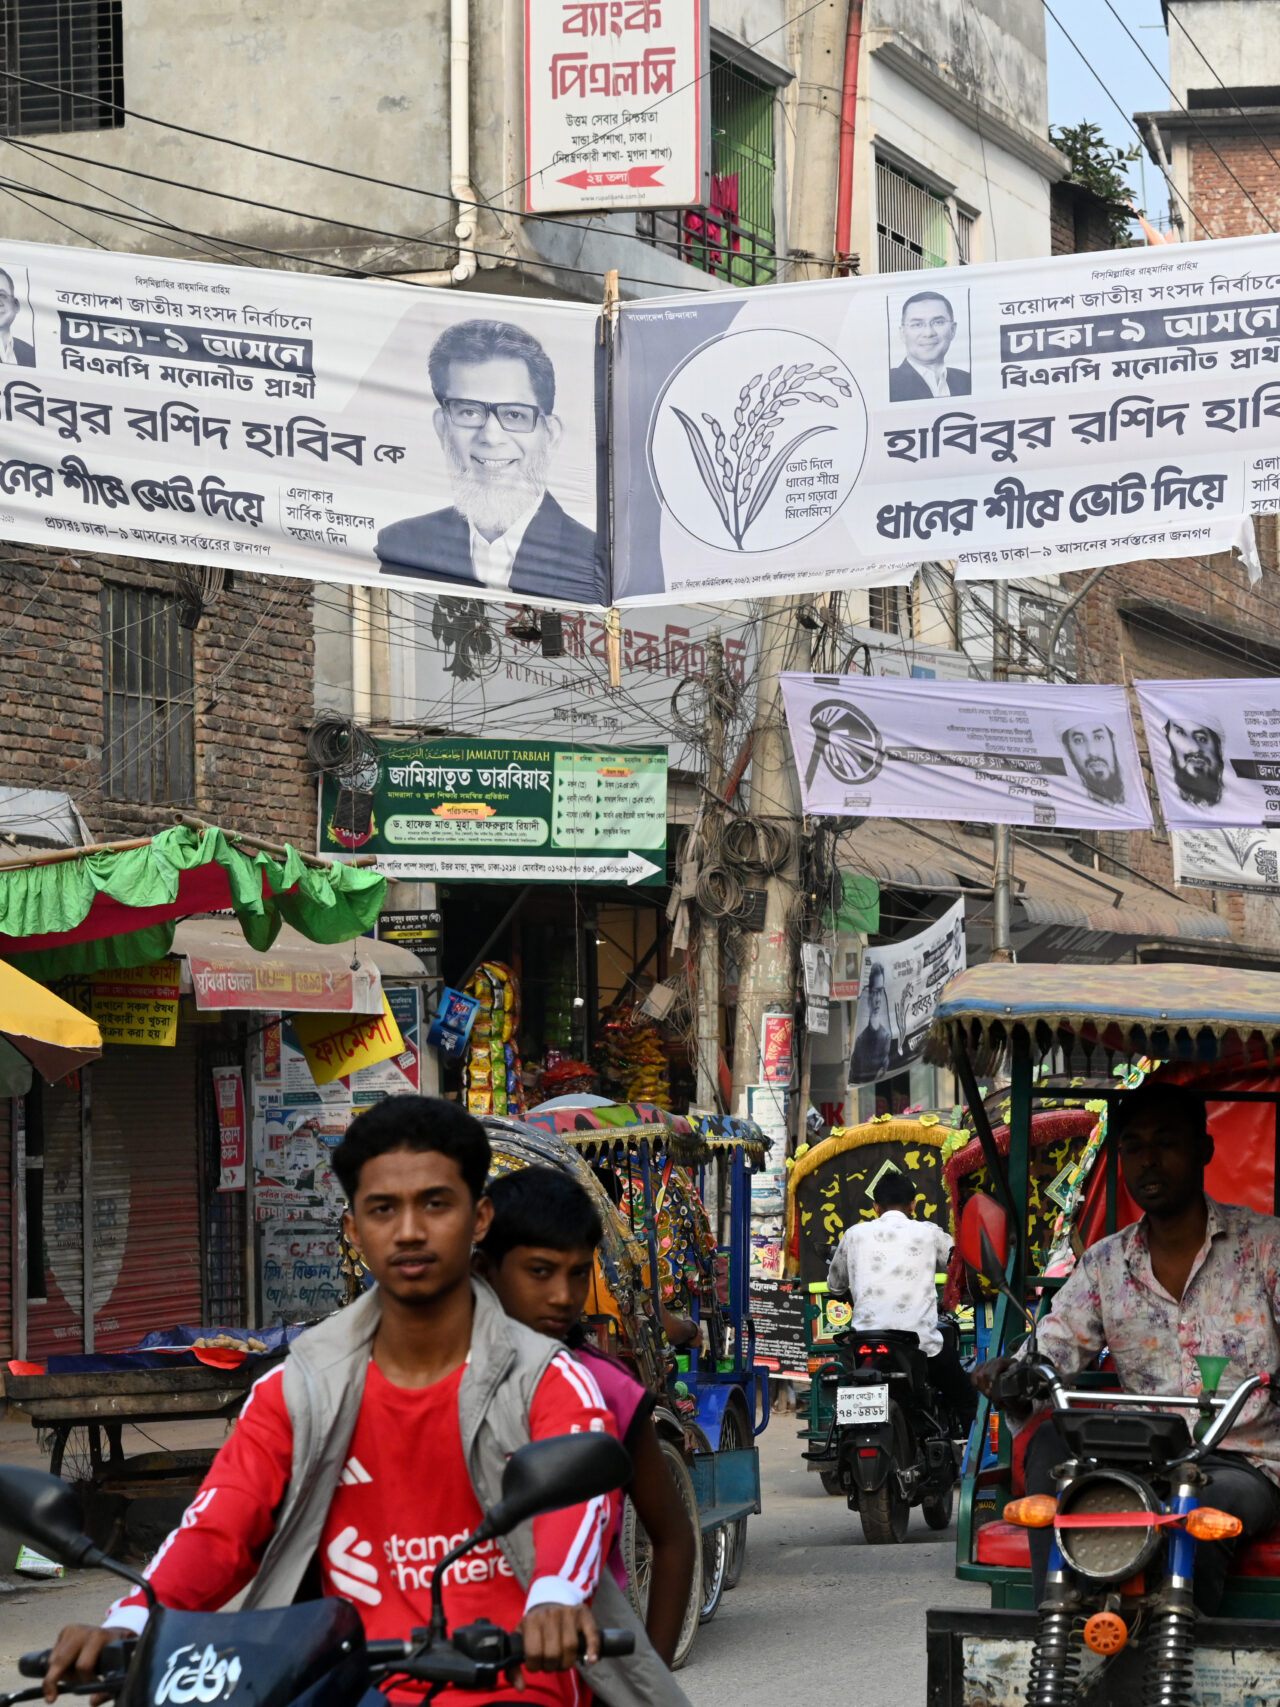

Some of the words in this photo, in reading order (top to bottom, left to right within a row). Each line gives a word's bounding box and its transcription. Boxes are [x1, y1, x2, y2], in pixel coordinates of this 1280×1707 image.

[563, 0, 661, 38] ব্যাংক
[549, 47, 676, 100] পিএলসি
[565, 114, 588, 127] উত্তম
[591, 112, 618, 125] সেবার
[622, 110, 658, 125] নিশ্চয়তা
[572, 136, 589, 147] মান্ডা
[629, 133, 647, 144] ঢাকা
[57, 290, 122, 310] ত্রয়োদশ
[127, 298, 182, 317] জাতীয়
[187, 304, 236, 323] সংসদ
[241, 306, 311, 330] নির্বাচনে
[999, 294, 1074, 315] ত্রয়োদশ
[1079, 285, 1142, 306] জাতীয়
[1148, 282, 1204, 299] সংসদ
[66, 318, 187, 352] ঢাকা-৯
[201, 334, 304, 368] আসনে
[1007, 318, 1145, 353] ঢাকা-৯
[1163, 305, 1278, 337] আসনে
[62, 348, 149, 379] বিএনপি
[159, 365, 253, 391] মনোনীত
[265, 371, 316, 399] প্রার্থী
[1001, 357, 1100, 388] বিএনপি
[1111, 346, 1218, 378] মনোনীত
[0, 380, 112, 442] বিবুর
[124, 401, 230, 449] রশিদ
[242, 415, 366, 465] হাবিব
[374, 444, 405, 463] কে
[884, 412, 1055, 463] হাবিবুর
[1068, 395, 1189, 444] রশিদ
[786, 459, 807, 472] ভোট
[809, 459, 832, 469] দিলে
[786, 476, 814, 487] ধানের
[816, 472, 839, 484] শীষে
[56, 455, 129, 508] শীষে
[130, 475, 195, 512] ভোট
[197, 475, 264, 527] দিয়ে
[286, 488, 332, 503] এলাকার
[785, 493, 805, 503] দেশ
[808, 490, 837, 502] গড়বো
[876, 498, 977, 539] ধানের
[983, 477, 1063, 529] শীষে
[1069, 472, 1146, 522] ভোট
[1151, 465, 1227, 511] দিয়ে
[286, 505, 321, 521] সার্বিক
[324, 508, 374, 529] উন্নয়নের
[786, 506, 832, 520] মিলেমিশে
[466, 750, 509, 761] JAMIATUT
[512, 751, 550, 761] TARBIAH
[388, 761, 472, 792] জামিয়াতুত
[476, 763, 551, 792] তারবিয়াহ
[452, 1004, 471, 1012] Rin
